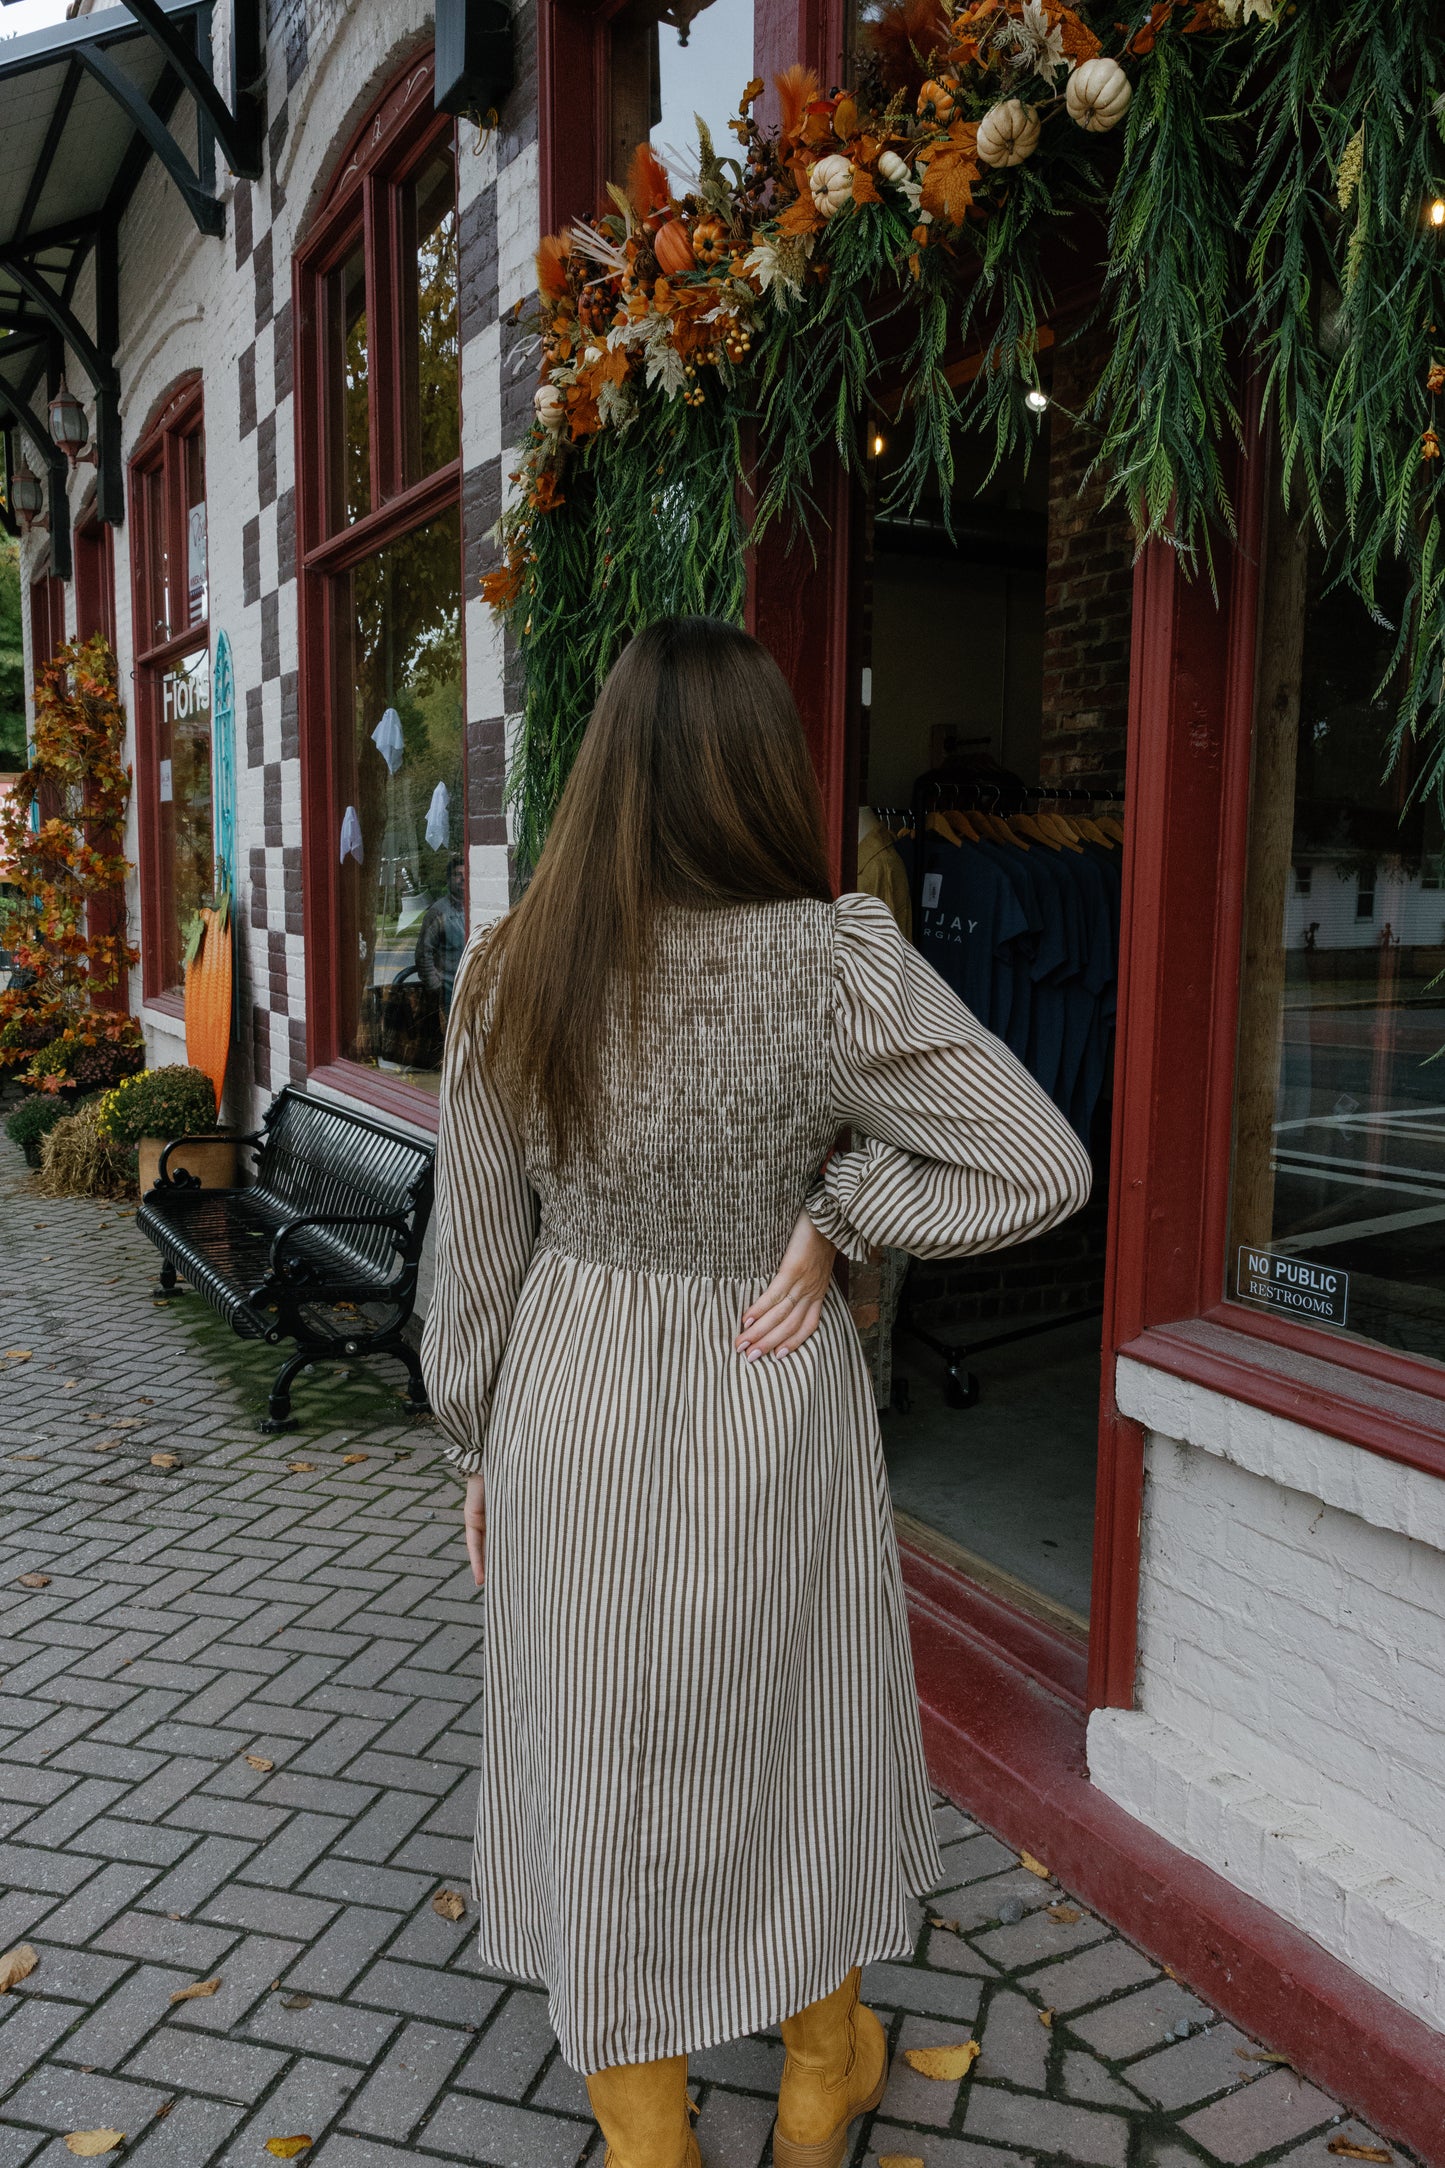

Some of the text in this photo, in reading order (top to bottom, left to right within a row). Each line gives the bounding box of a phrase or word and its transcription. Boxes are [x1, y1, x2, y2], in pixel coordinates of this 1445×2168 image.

[1248, 1254, 1337, 1293] NO PUBLIC
[1249, 1281, 1334, 1316] RESTROOMS
